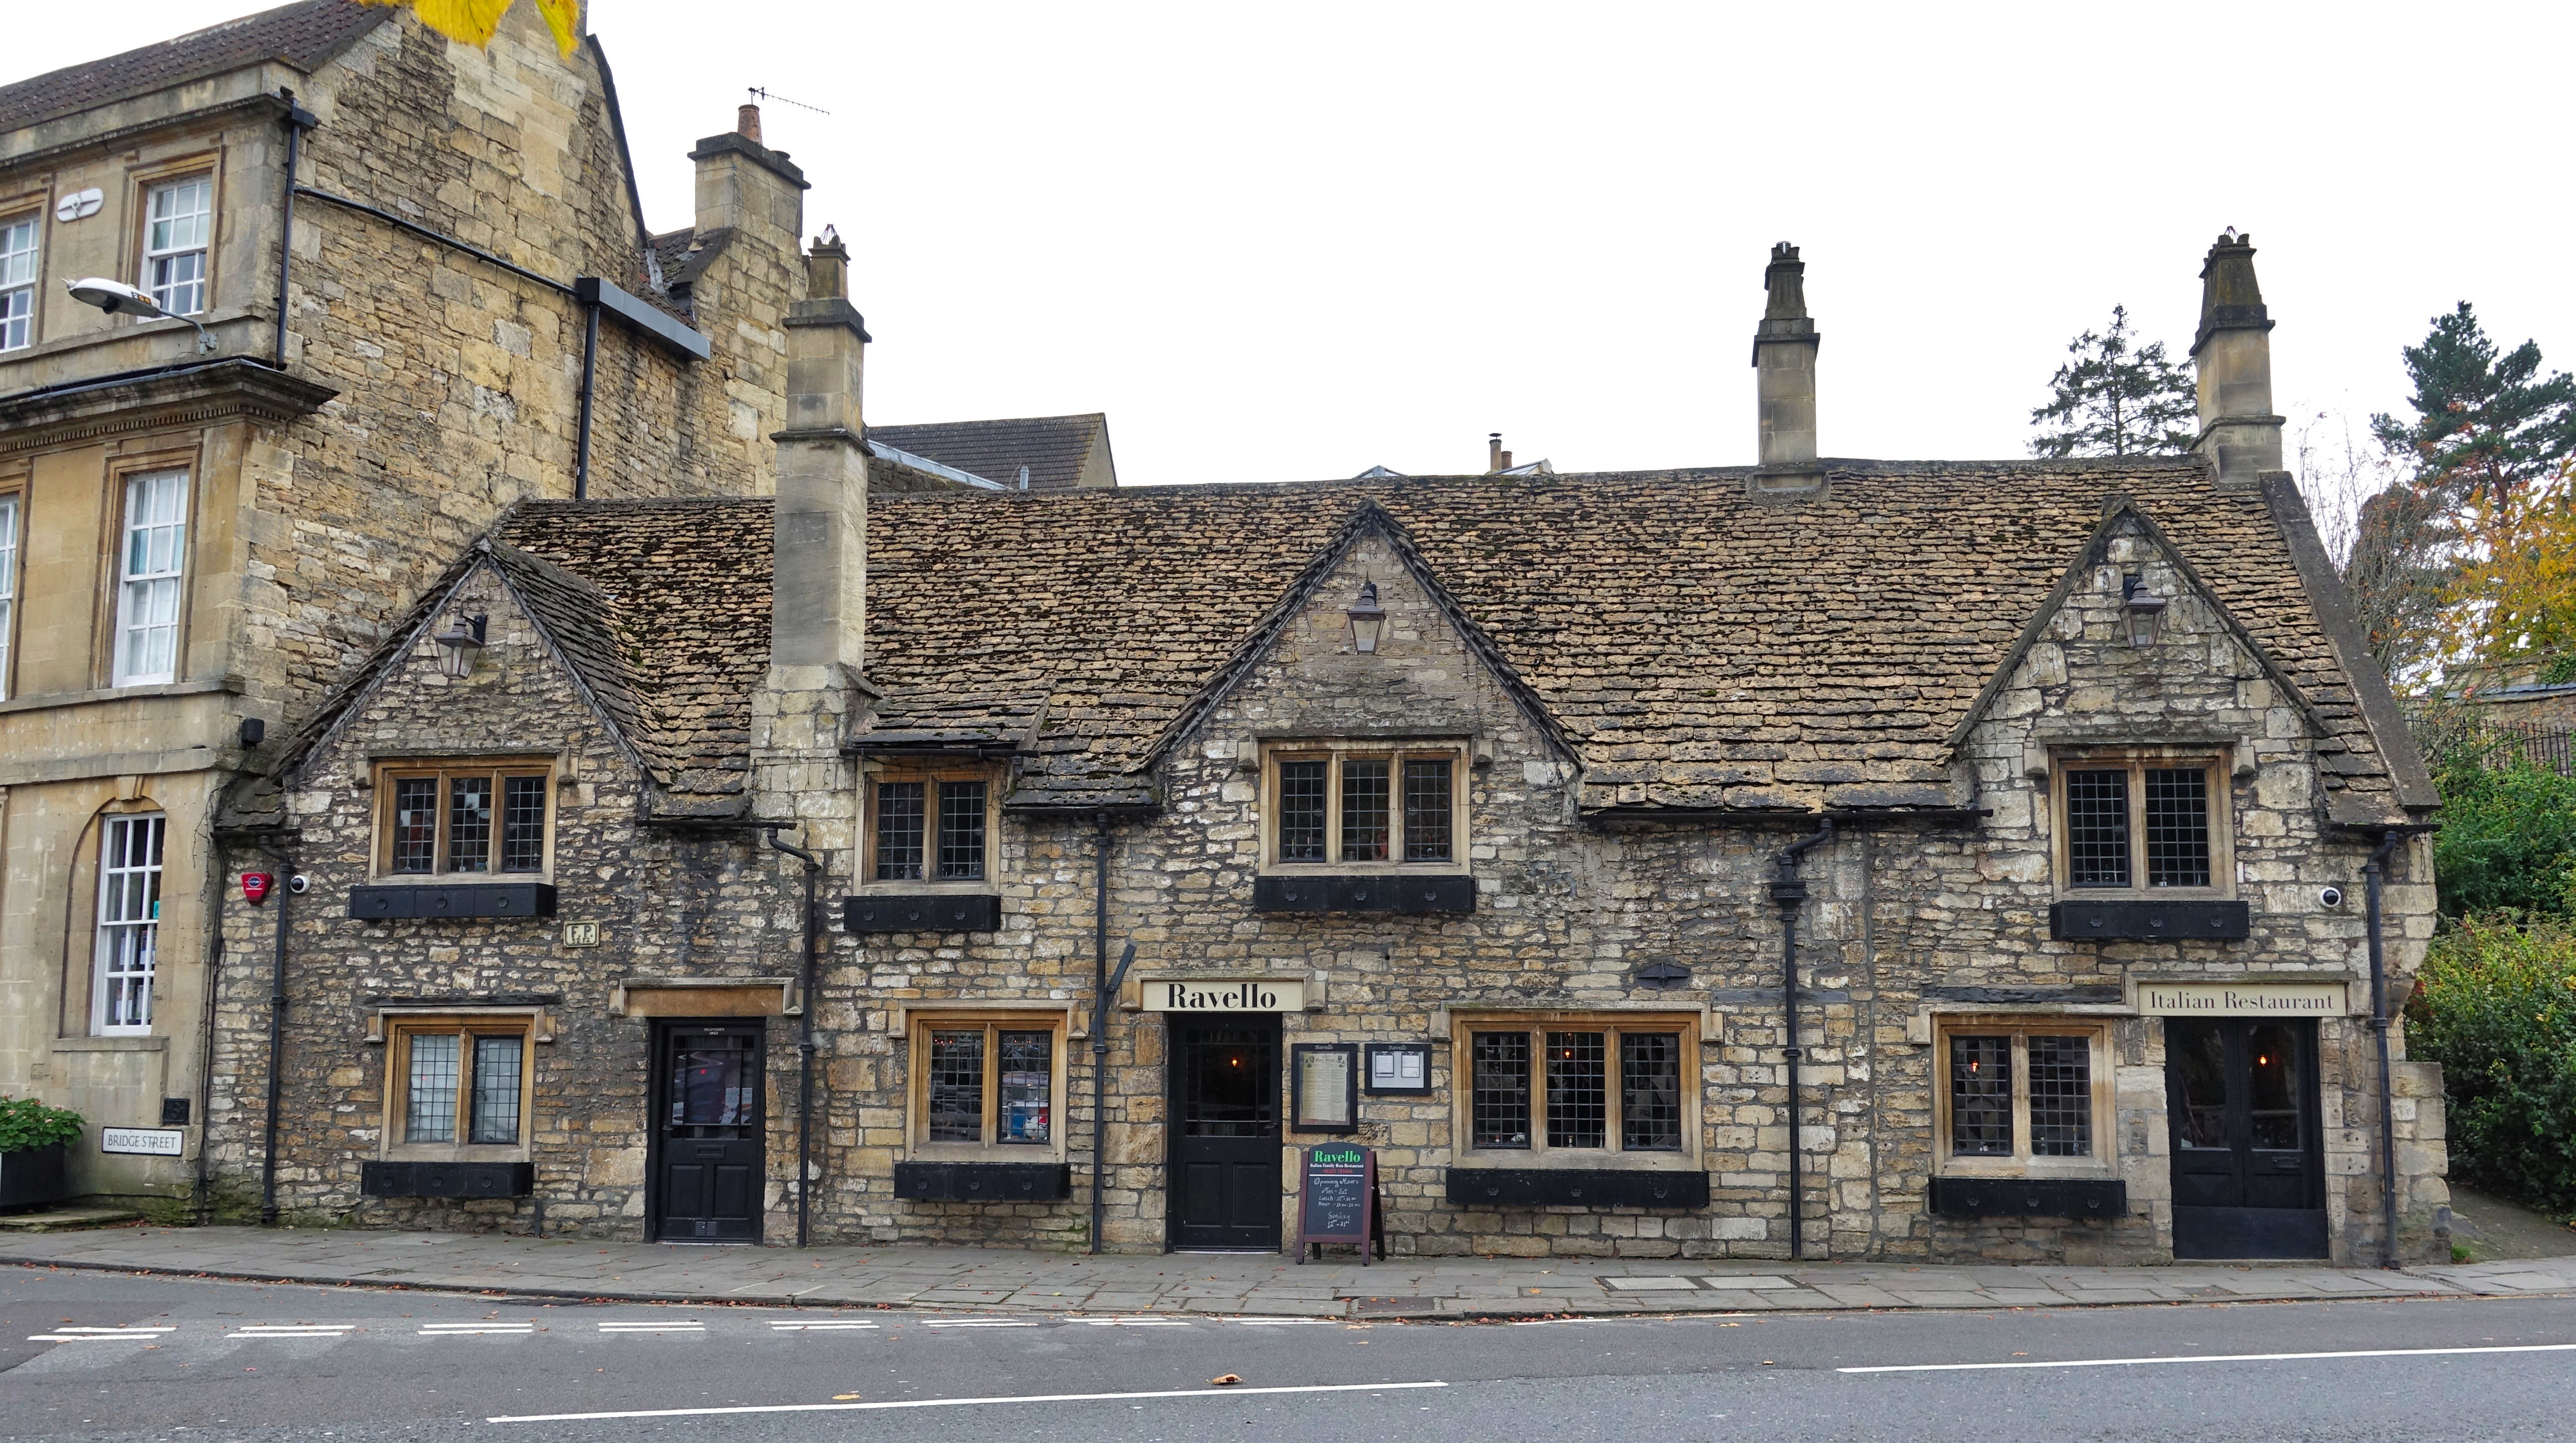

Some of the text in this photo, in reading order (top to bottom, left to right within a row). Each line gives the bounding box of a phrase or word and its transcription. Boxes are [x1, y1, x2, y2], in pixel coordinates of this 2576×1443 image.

[133, 293, 150, 304] 204
[1167, 983, 1276, 1009] Ravello
[2150, 991, 2335, 1010] Italian Restaurant
[108, 1134, 177, 1149] BRIDGE STREET
[1314, 1150, 1361, 1162] Ravello
[1314, 1177, 1339, 1188] Opening
[1328, 1211, 1350, 1220] Sunday
